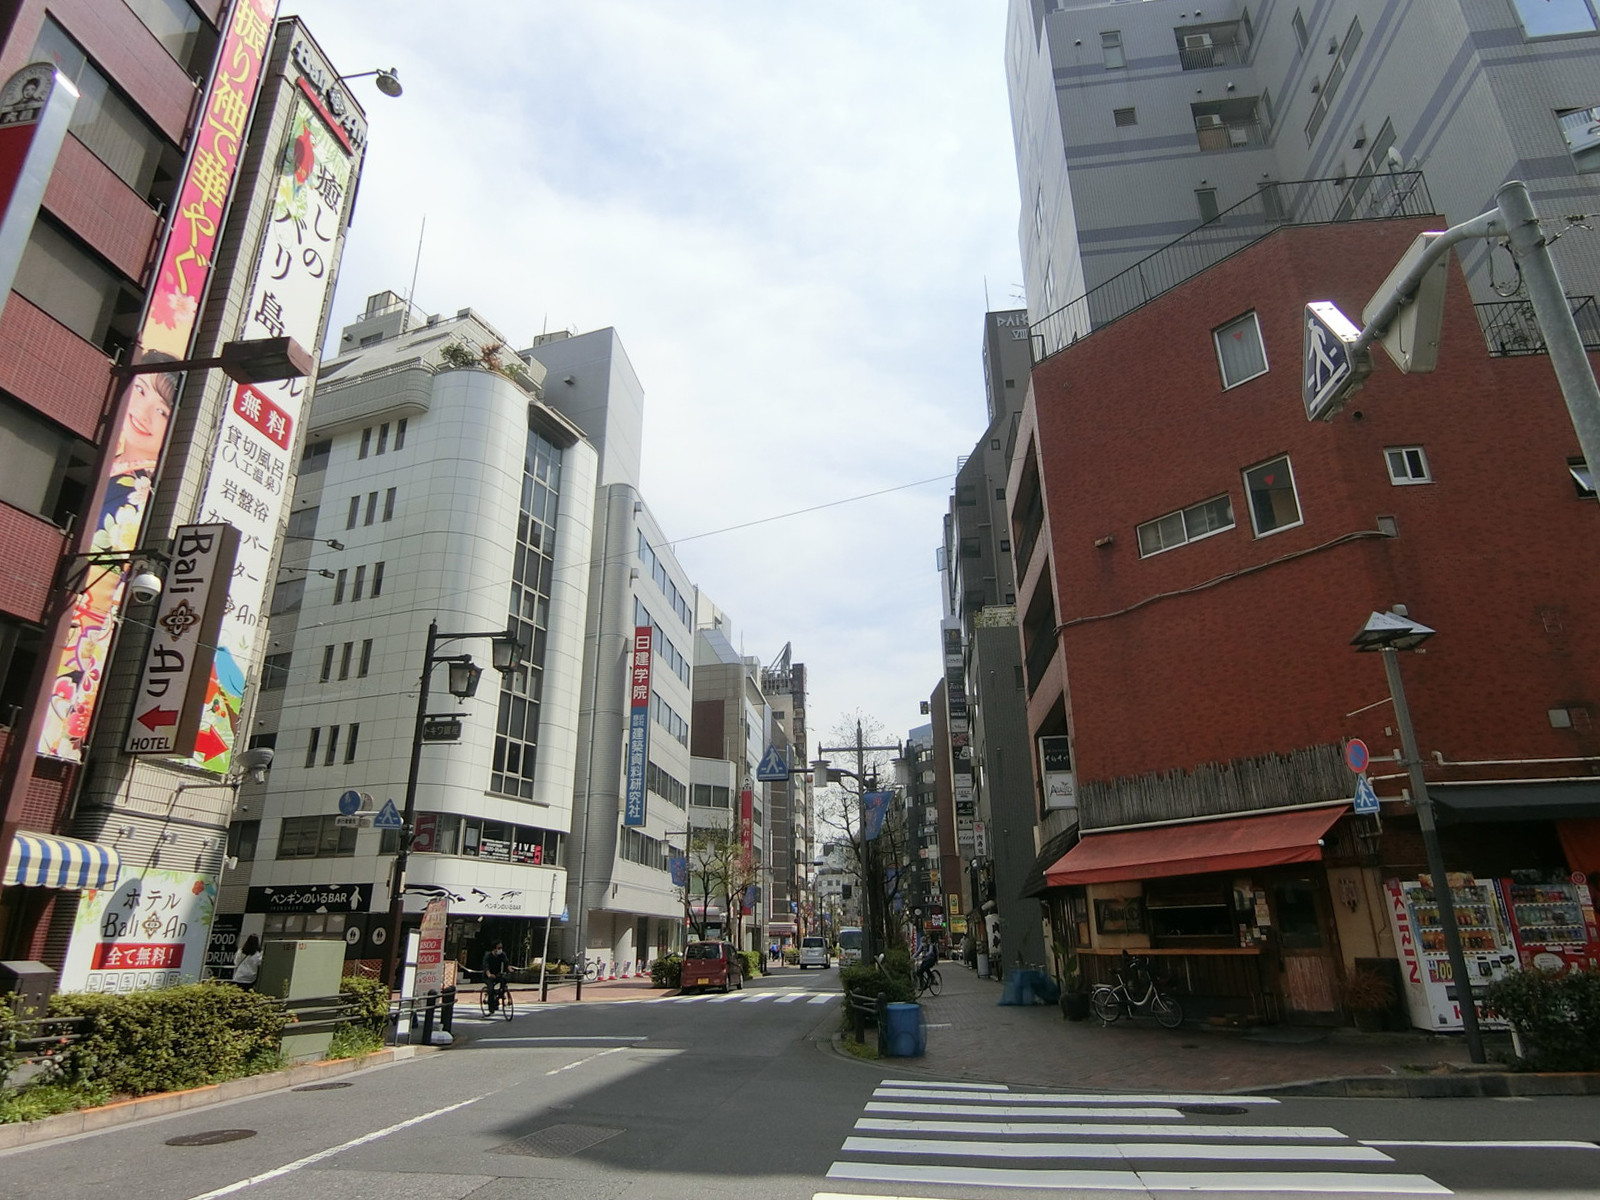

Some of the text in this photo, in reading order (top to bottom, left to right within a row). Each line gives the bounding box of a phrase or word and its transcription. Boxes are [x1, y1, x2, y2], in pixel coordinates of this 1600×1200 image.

[302, 164, 344, 279] 癒しの
[239, 388, 289, 442] 無料
[226, 424, 285, 481] 貸切風呂
[220, 478, 270, 523] 岩盤浴
[146, 528, 216, 698] Bali An
[235, 604, 257, 627] An
[632, 635, 651, 700] 日建学院
[130, 738, 171, 751] HOTEL
[628, 727, 645, 818] 建築資料研究社
[512, 841, 536, 853] FIVE
[123, 887, 181, 911] ホテル
[102, 912, 188, 938] Bali An
[210, 933, 236, 945] FOOD
[1392, 896, 1421, 984] KIRIN
